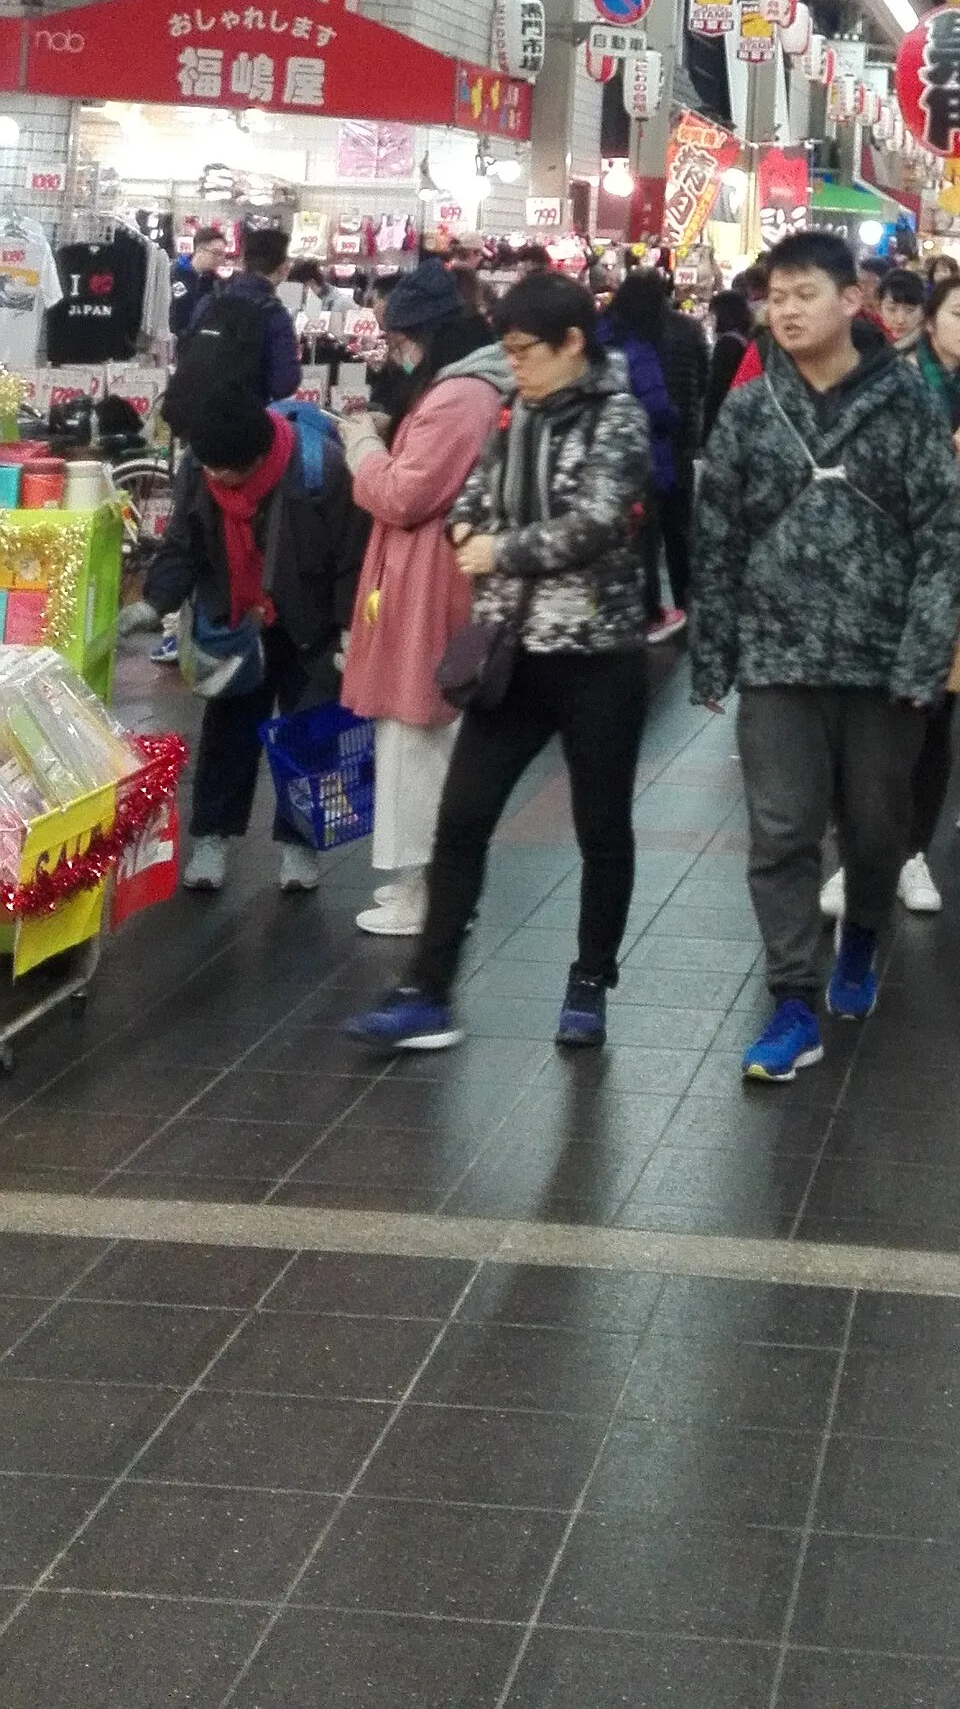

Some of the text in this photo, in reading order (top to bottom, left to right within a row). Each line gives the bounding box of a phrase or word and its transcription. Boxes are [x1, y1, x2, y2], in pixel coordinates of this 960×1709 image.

[168, 6, 338, 48] おしゃれします
[519, 3, 545, 72] 黒門市場
[592, 33, 644, 51] 自動車
[177, 46, 326, 106] 福嶋屋
[69, 273, 82, 296] I
[68, 304, 113, 316] JAPAN
